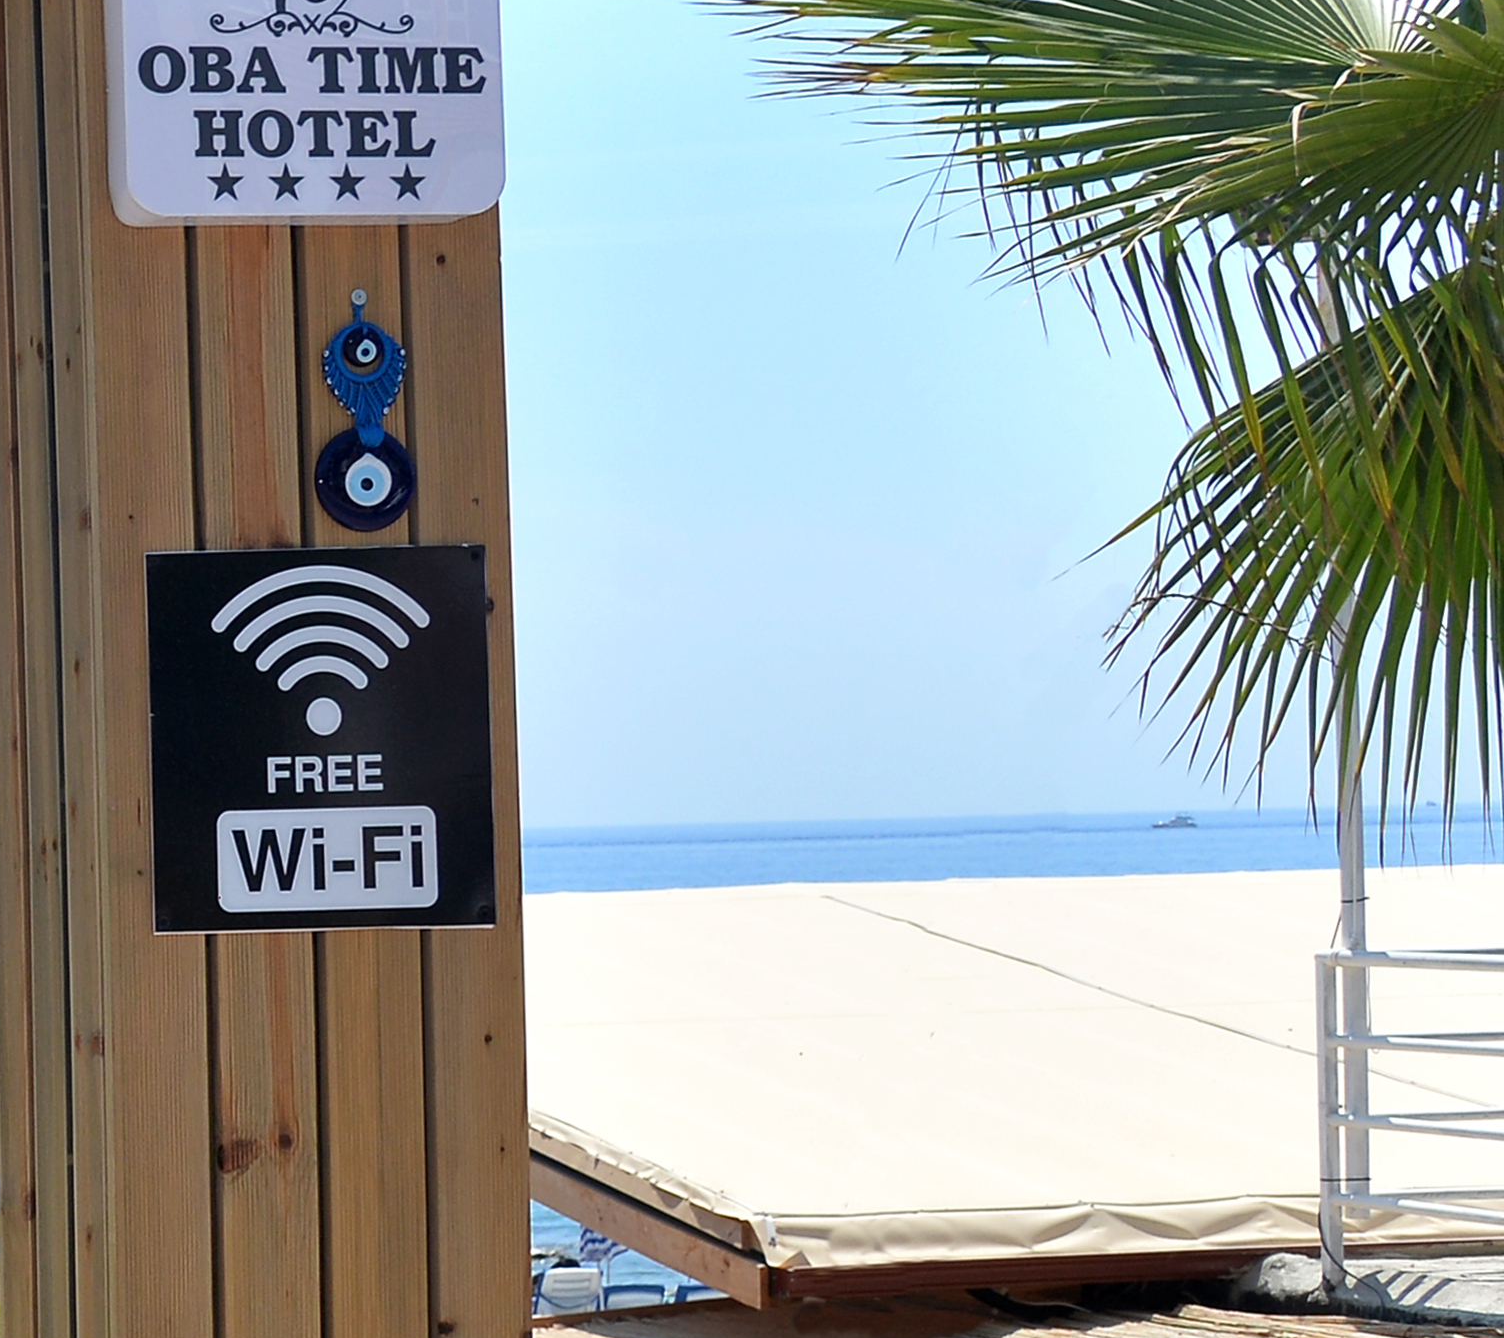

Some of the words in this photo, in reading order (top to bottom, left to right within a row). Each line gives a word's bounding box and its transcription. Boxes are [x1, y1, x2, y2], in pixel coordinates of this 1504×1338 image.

[137, 45, 286, 94] OBA
[307, 46, 487, 94] TIME
[193, 109, 437, 159] HOTEL
[266, 754, 384, 794] FREE
[231, 824, 425, 894] Wi-Fi
